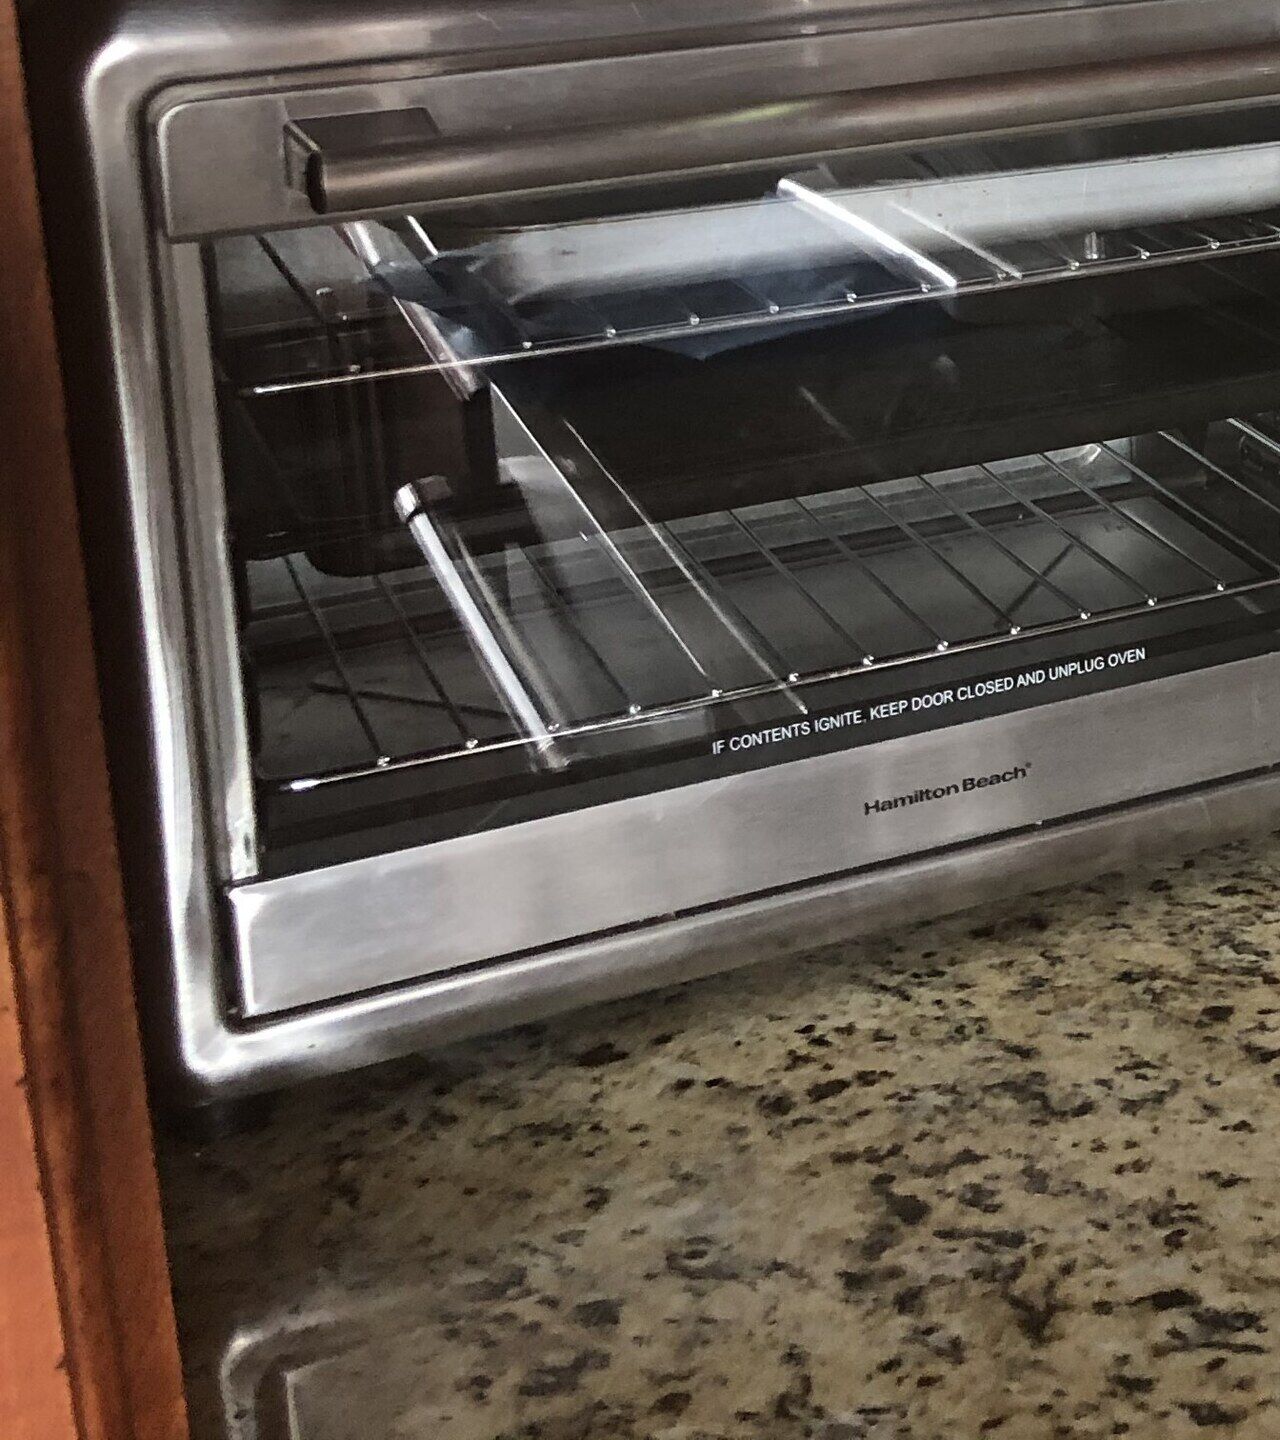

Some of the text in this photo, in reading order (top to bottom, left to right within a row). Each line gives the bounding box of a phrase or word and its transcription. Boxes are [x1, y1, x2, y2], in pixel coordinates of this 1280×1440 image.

[712, 739, 726, 755] IF
[729, 721, 811, 751] CONTENTS
[870, 700, 909, 721] KEEP
[911, 690, 953, 711] DOOR
[957, 676, 1014, 701] CLOSED
[1016, 669, 1046, 688] AND
[1049, 656, 1105, 681] UNPLUG
[1107, 647, 1146, 668] OVEN
[863, 782, 960, 816] Hamilton
